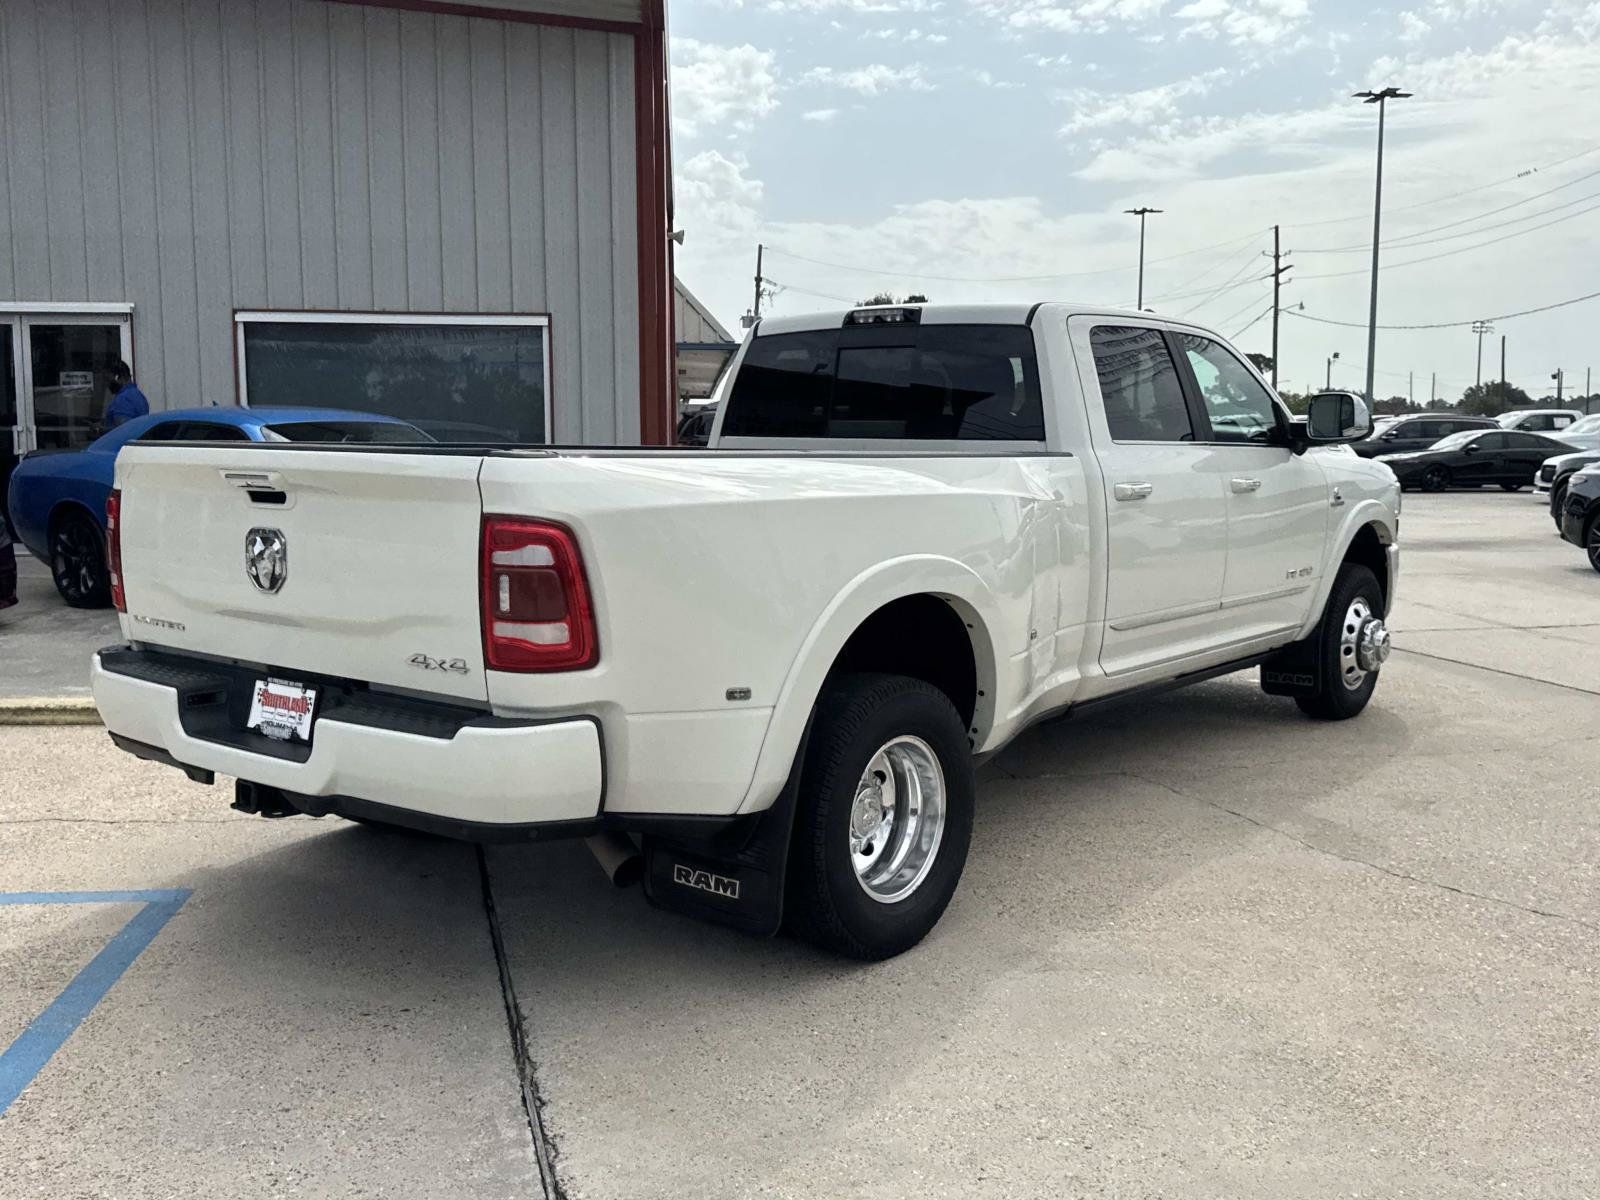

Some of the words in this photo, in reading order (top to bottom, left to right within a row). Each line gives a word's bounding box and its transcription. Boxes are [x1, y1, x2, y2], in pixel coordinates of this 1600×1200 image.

[1266, 671, 1314, 687] RAM
[262, 688, 308, 716] SOUTHLAND
[674, 863, 740, 899] RAM
